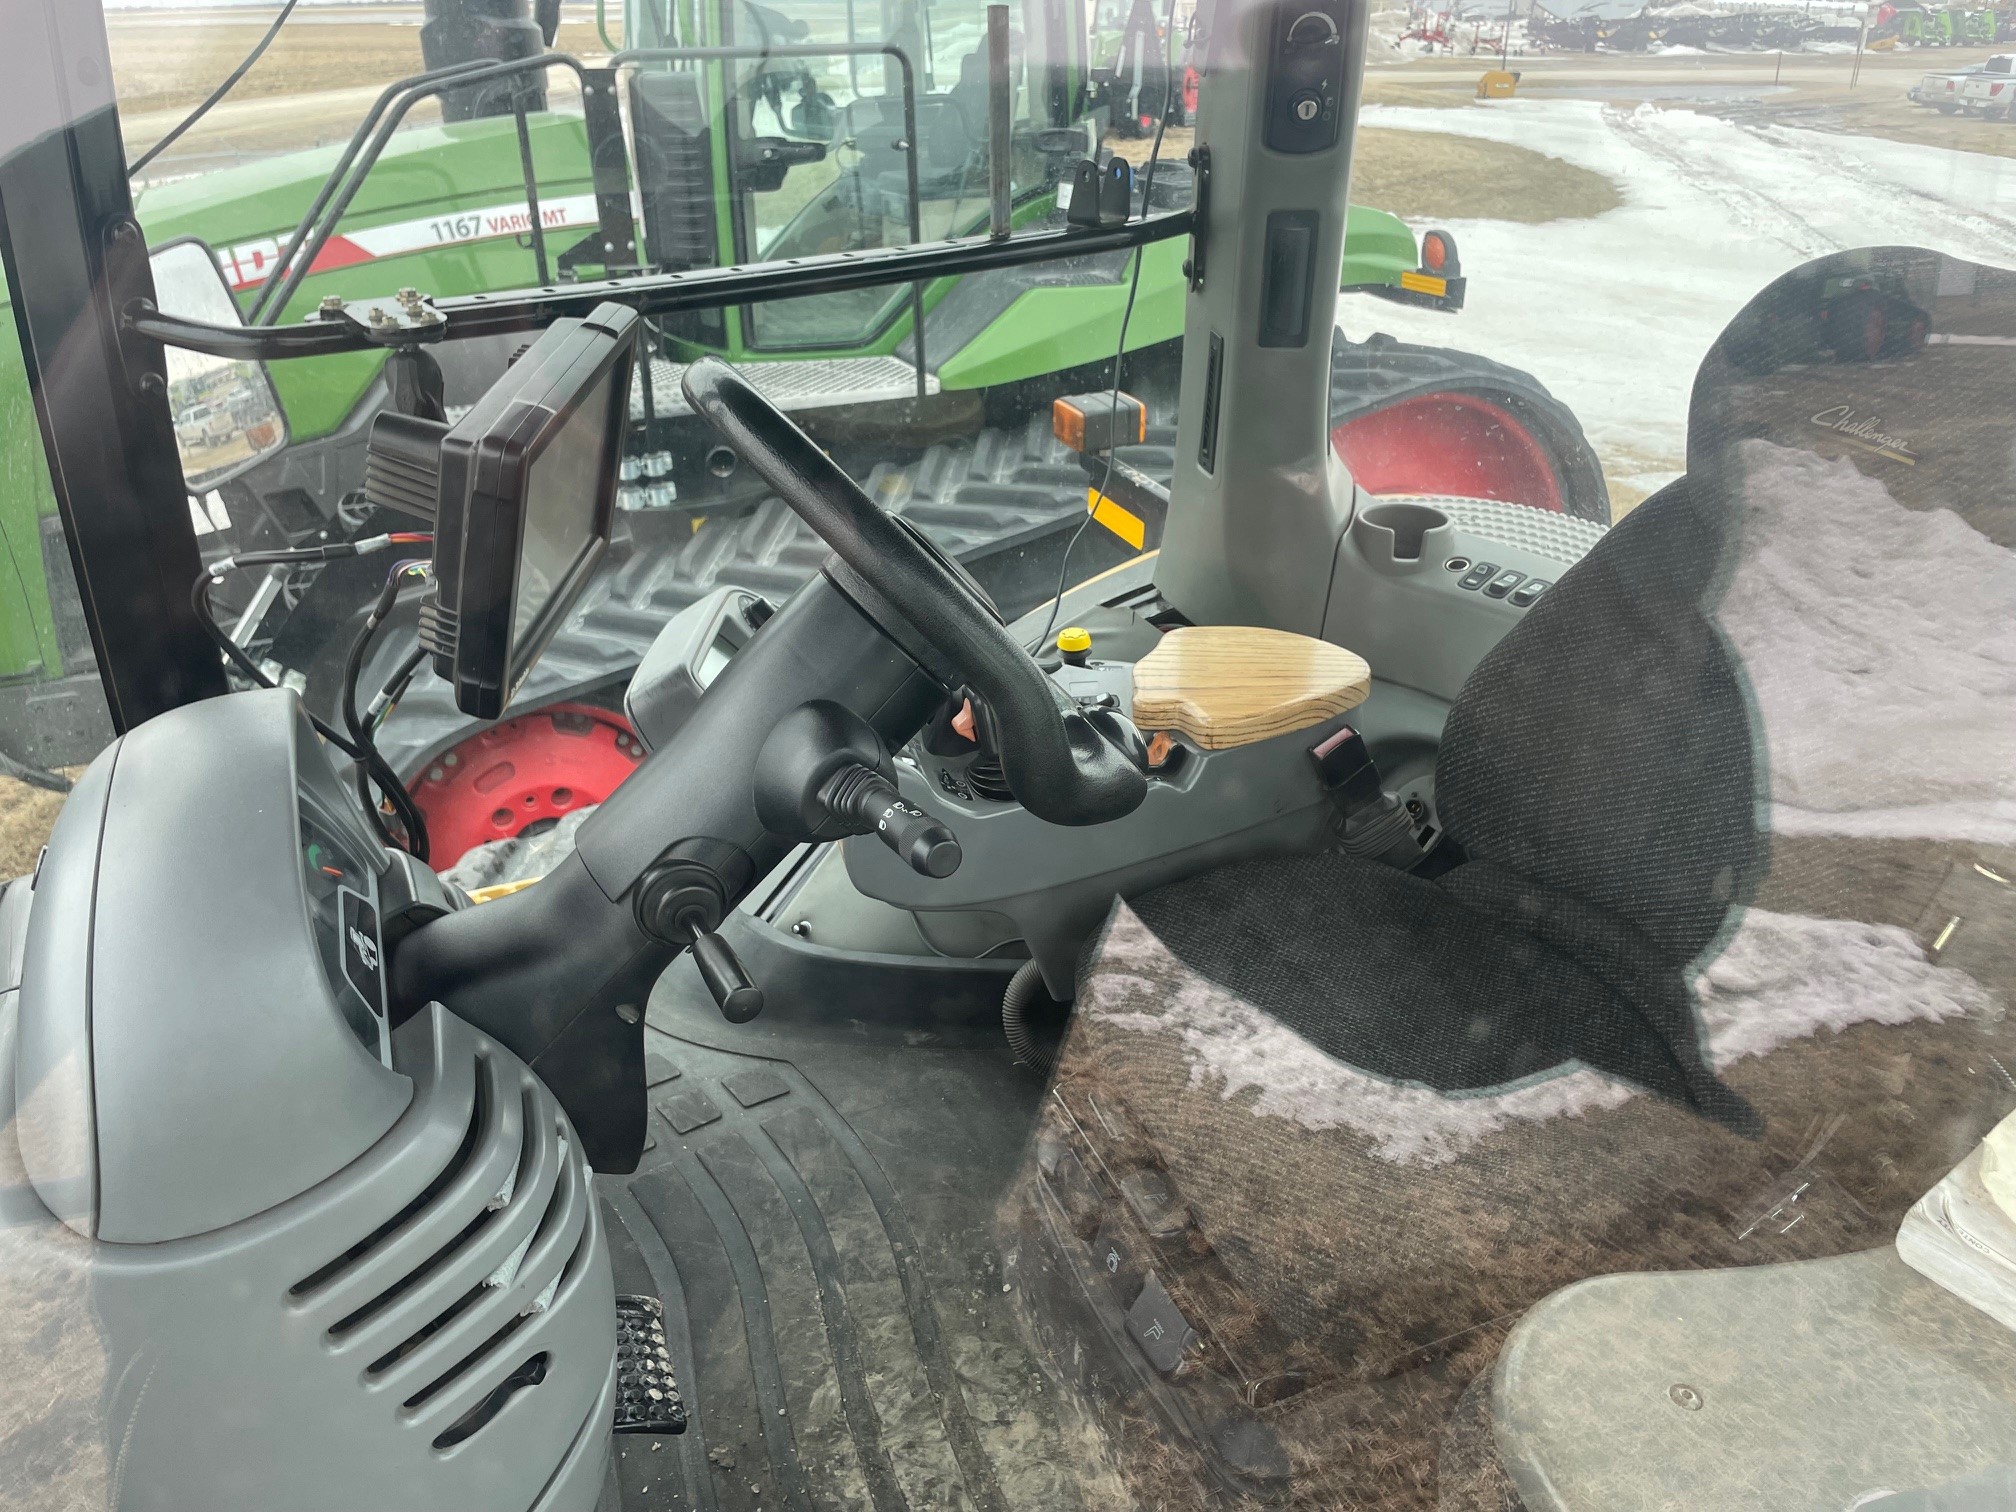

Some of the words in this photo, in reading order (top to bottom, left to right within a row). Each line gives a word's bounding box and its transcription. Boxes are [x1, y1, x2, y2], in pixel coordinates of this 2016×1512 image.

[430, 215, 482, 241] 1167
[542, 208, 567, 226] MT
[1811, 405, 1919, 455] Challenger
